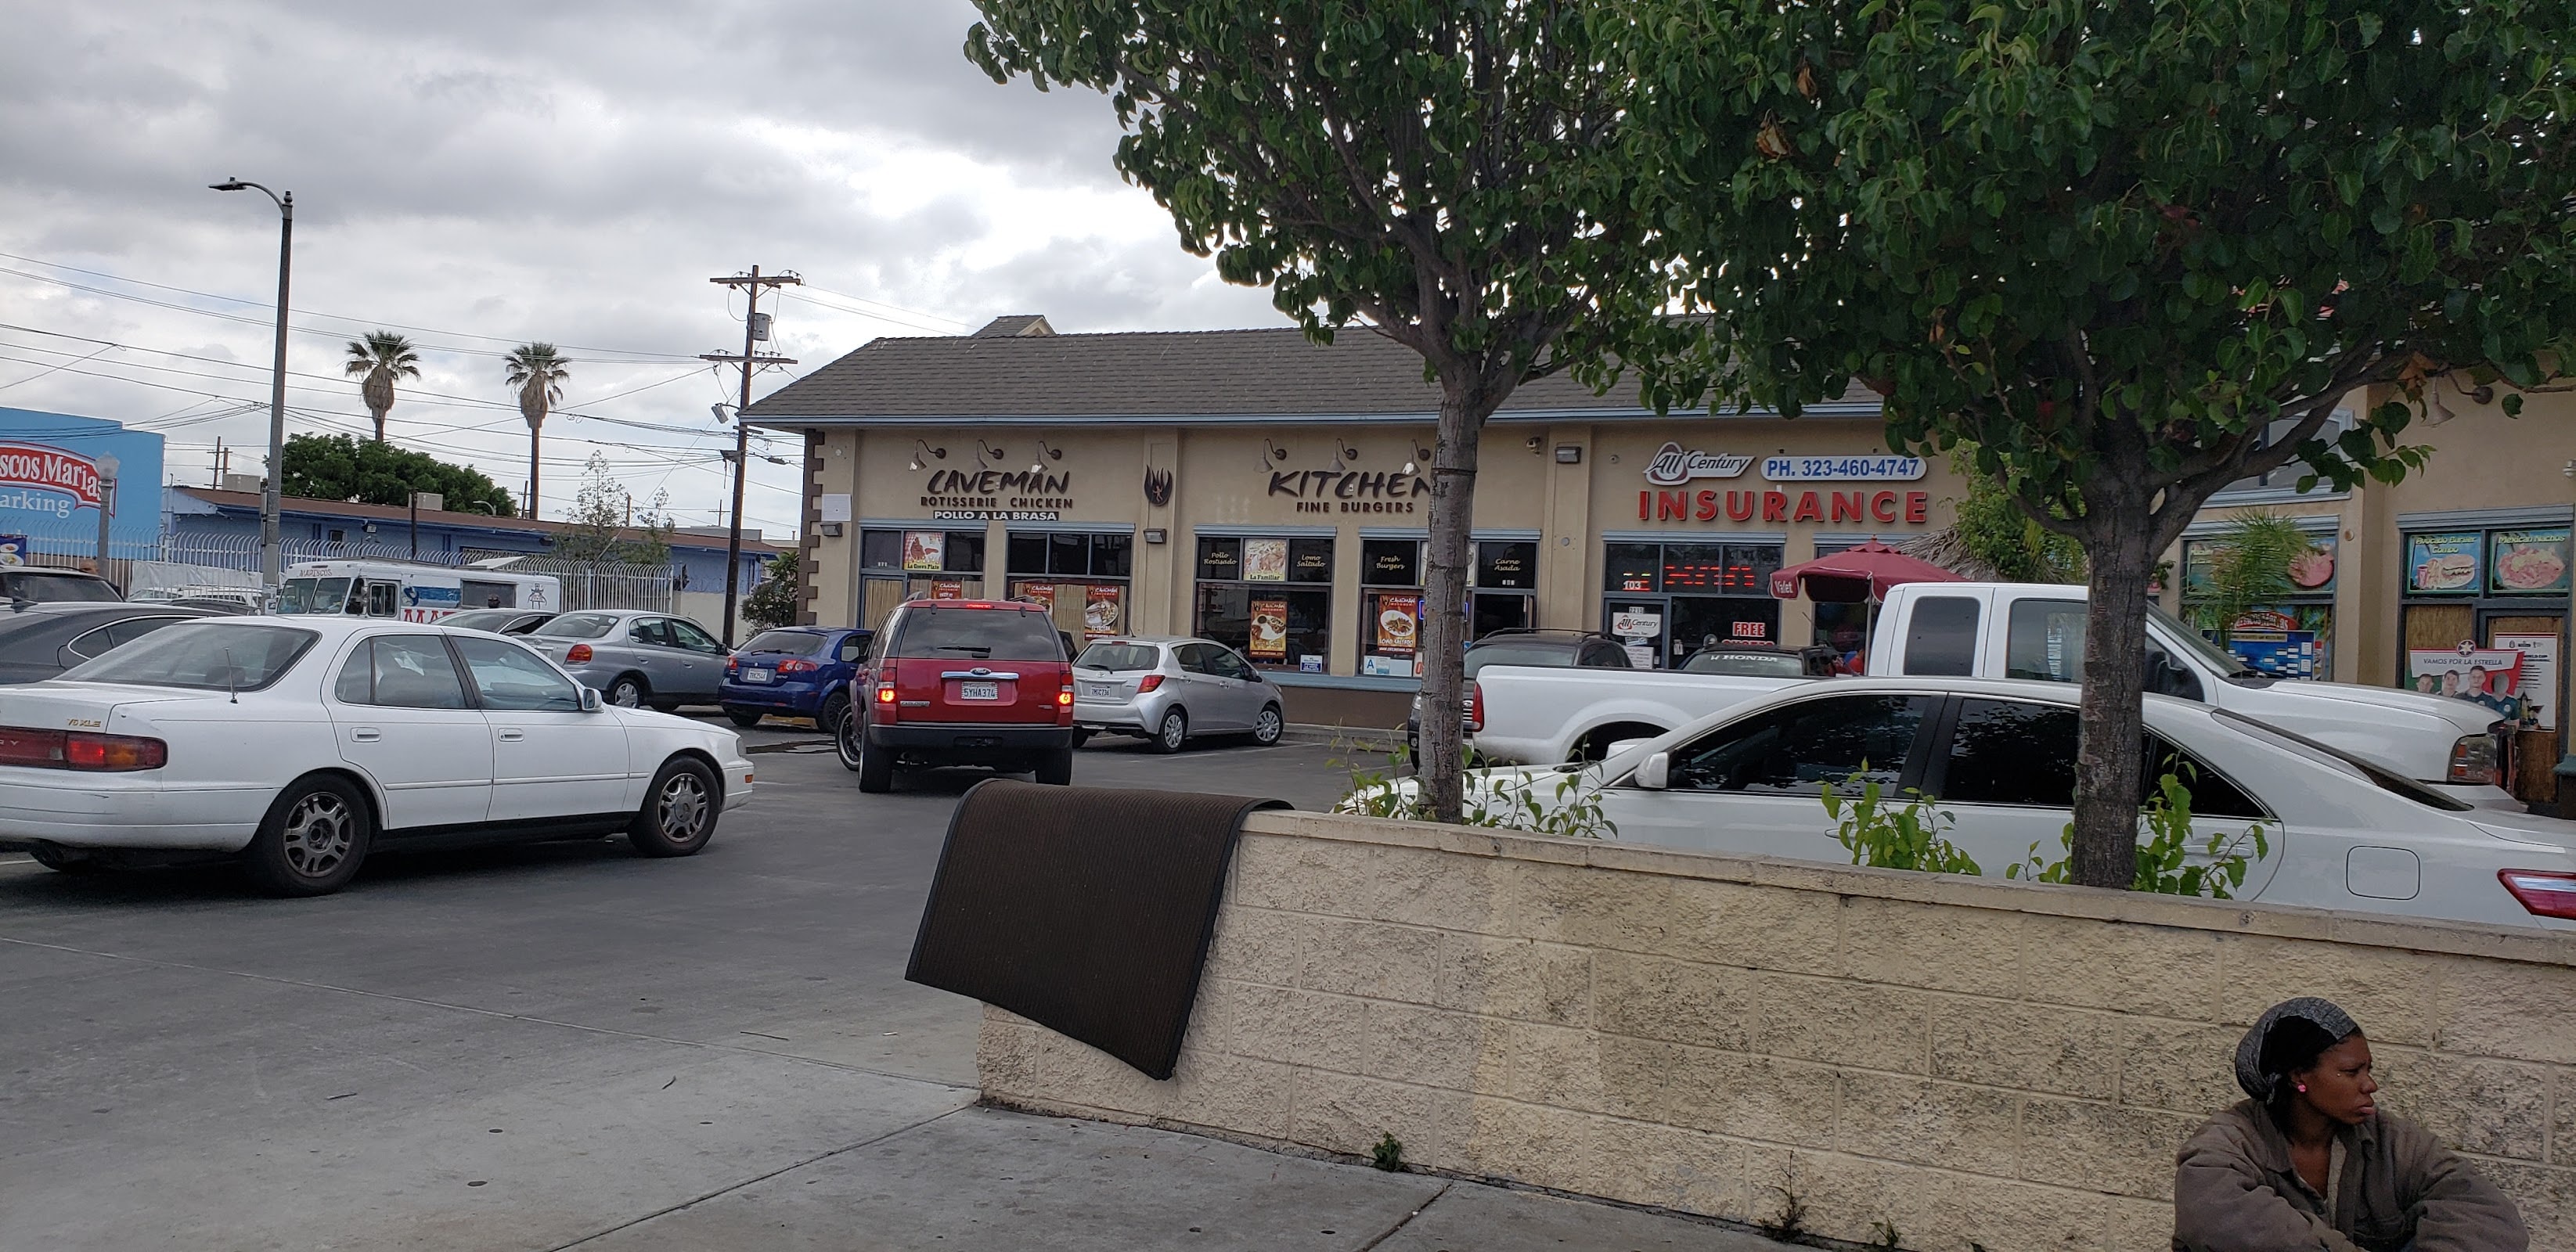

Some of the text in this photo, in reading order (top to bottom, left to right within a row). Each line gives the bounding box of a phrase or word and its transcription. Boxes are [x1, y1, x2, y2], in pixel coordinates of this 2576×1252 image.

[1648, 451, 1748, 474] All Century
[1767, 459, 1918, 477] PH. 323-460-4747
[928, 470, 1070, 495] CAVEMAN
[921, 496, 1073, 509] ROTISSERIE CHICKEN
[1296, 502, 1414, 513] FINE BURGERS
[1638, 489, 1928, 523] INSURANCE
[934, 511, 1057, 520] POLLO A LA BRASA
[1376, 563, 1405, 571] Burgers
[1774, 580, 1793, 594] Valet
[1632, 619, 1658, 628] Century
[1733, 622, 1764, 636] FREE
[1367, 659, 1374, 668] A
[964, 689, 996, 697] 5YHA374
